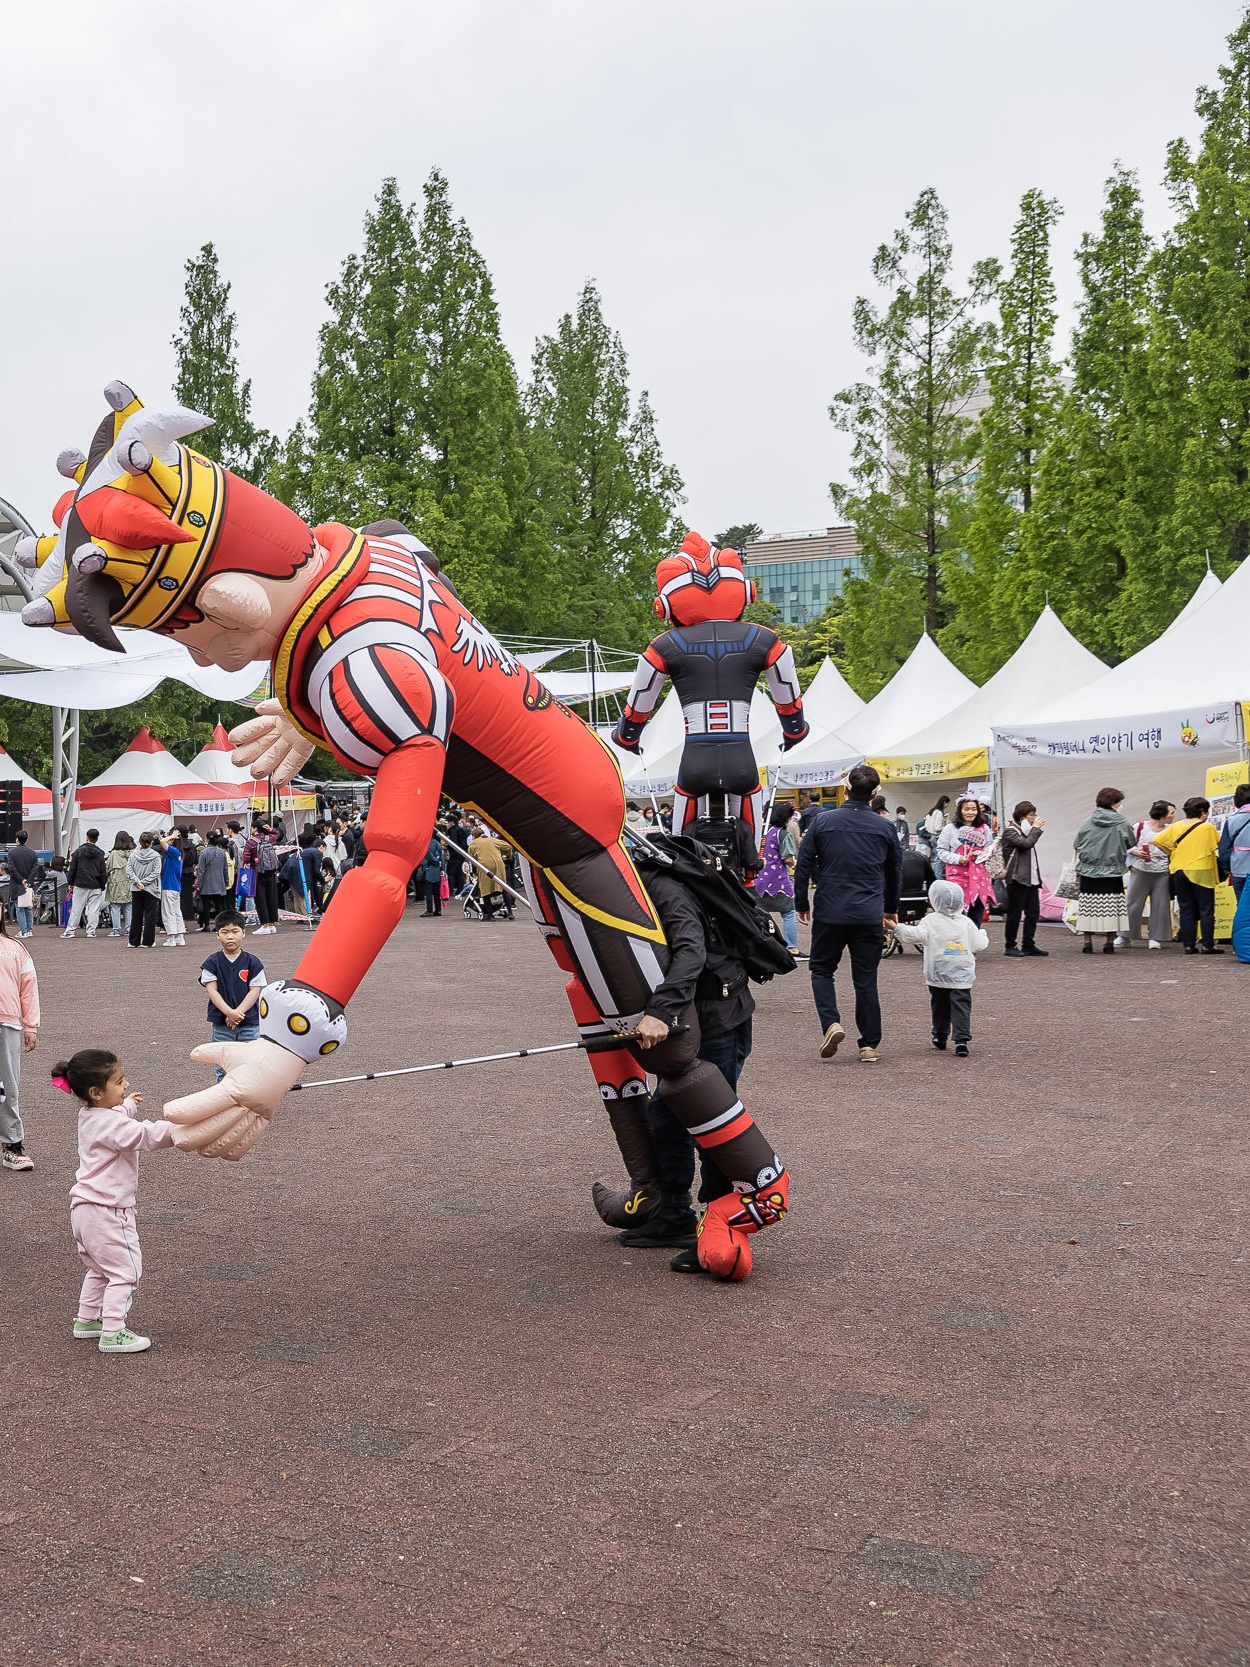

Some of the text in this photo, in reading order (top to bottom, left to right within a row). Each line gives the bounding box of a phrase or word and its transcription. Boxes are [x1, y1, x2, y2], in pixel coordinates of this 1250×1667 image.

[1047, 739, 1086, 756] 해피할머니
[1088, 730, 1133, 754] 옛이야기
[1138, 727, 1162, 749] 여행
[933, 760, 950, 774] 만들기
